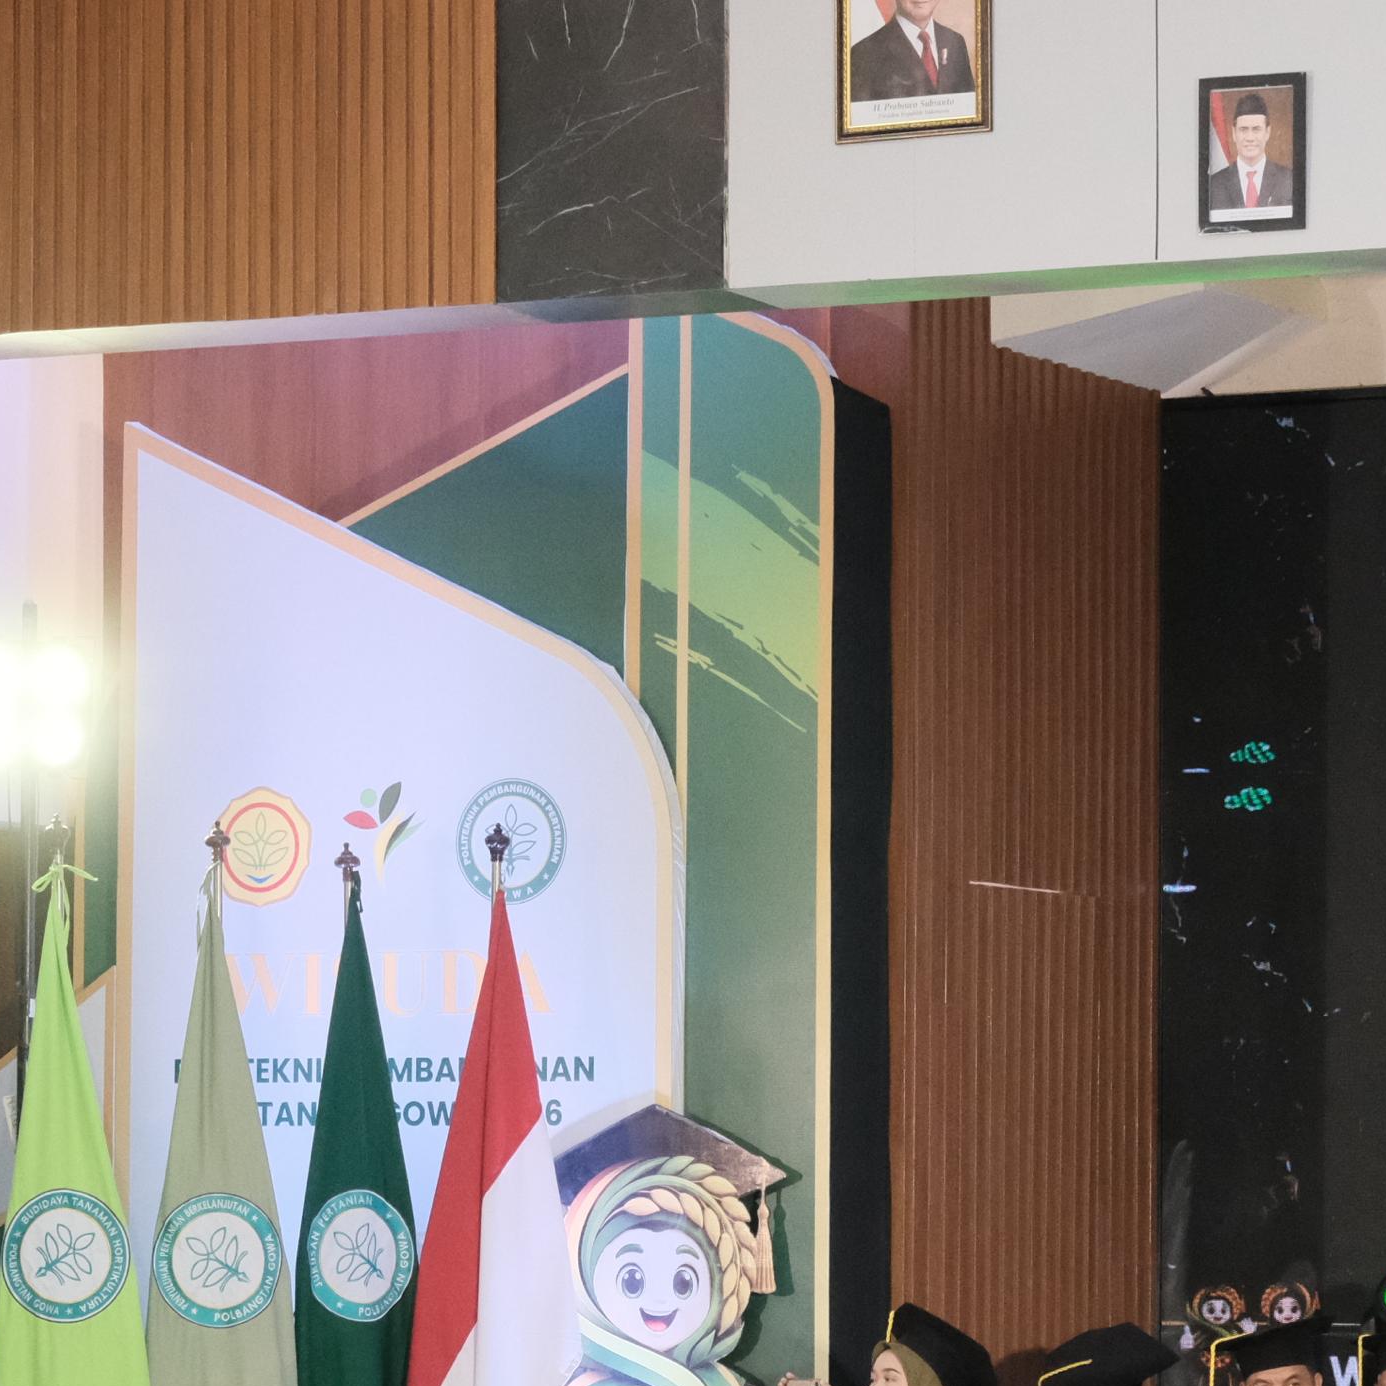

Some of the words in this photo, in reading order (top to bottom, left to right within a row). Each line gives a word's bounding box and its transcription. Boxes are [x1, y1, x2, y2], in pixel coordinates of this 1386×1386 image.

[461, 805, 479, 866] POLITEKNIK
[224, 950, 557, 1016] WIUDA
[21, 1196, 69, 1225] BUDIDAYA
[72, 1197, 118, 1237] TANAMAN
[317, 1195, 374, 1228] PERTANIAN
[9, 1243, 33, 1302] POLBANGTAN
[34, 1300, 60, 1315] GOWA
[79, 1240, 124, 1313] HORTIKULTURA
[214, 1277, 274, 1322] POLBANGTAN
[265, 1233, 277, 1271] GOWA
[397, 1231, 410, 1269] GOWA
